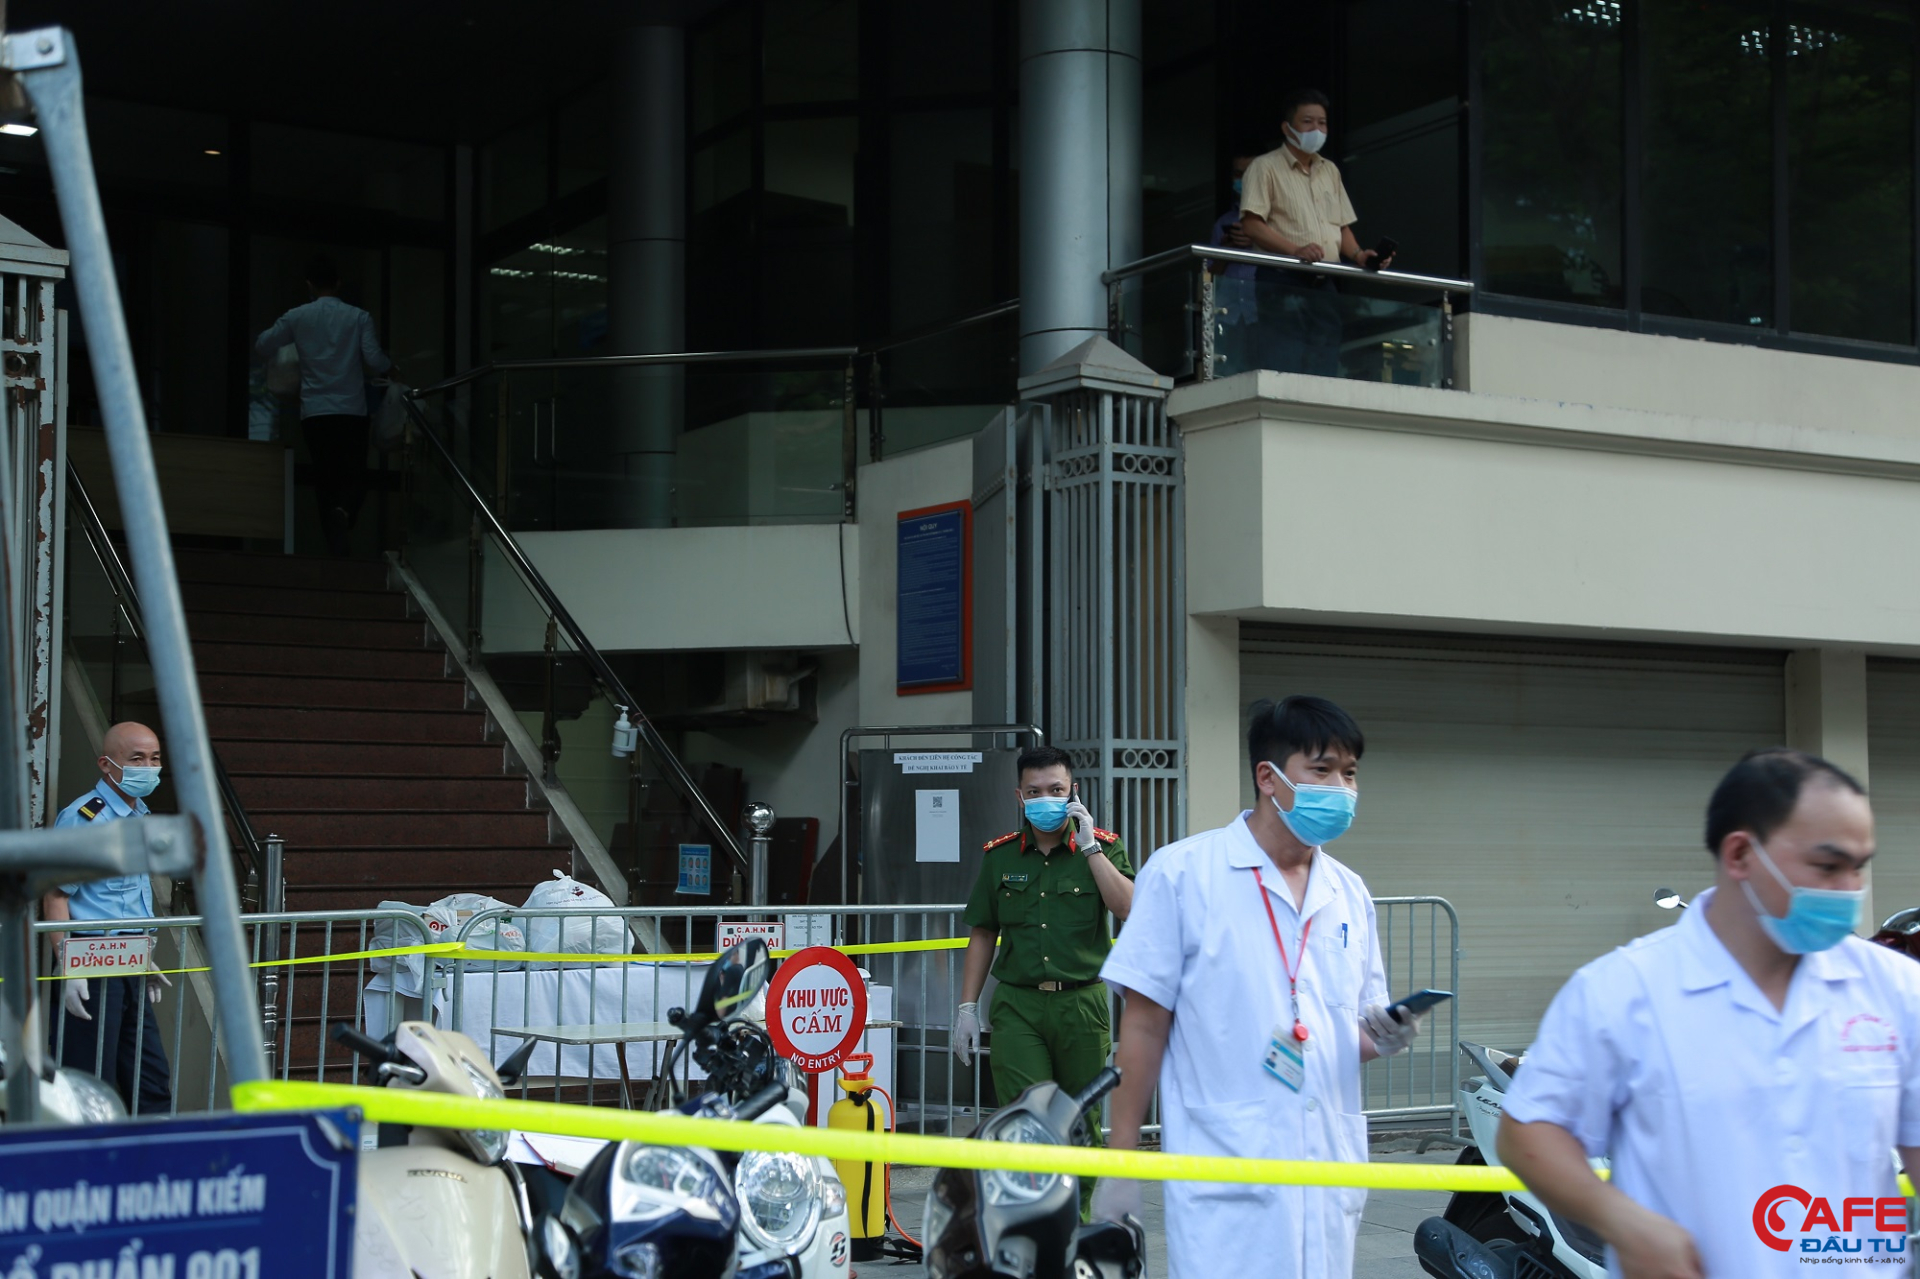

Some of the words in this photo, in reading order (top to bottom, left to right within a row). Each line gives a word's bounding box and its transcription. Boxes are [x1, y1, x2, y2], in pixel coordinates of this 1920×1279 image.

[736, 926, 766, 934] C.A.H.N
[89, 942, 126, 951] C.A.H.N
[767, 938, 779, 950] ẠI
[70, 952, 114, 968] DỪNG
[118, 954, 143, 968] LẠI
[787, 989, 816, 1009] KHU
[820, 987, 848, 1011] VỰC
[791, 1009, 842, 1034] CẤM
[790, 1052, 806, 1067] NO
[807, 1049, 841, 1069] ENTRY
[33, 1179, 112, 1234] QUẬN
[116, 1173, 193, 1223] HOÀN
[197, 1163, 266, 1216] KIẾM
